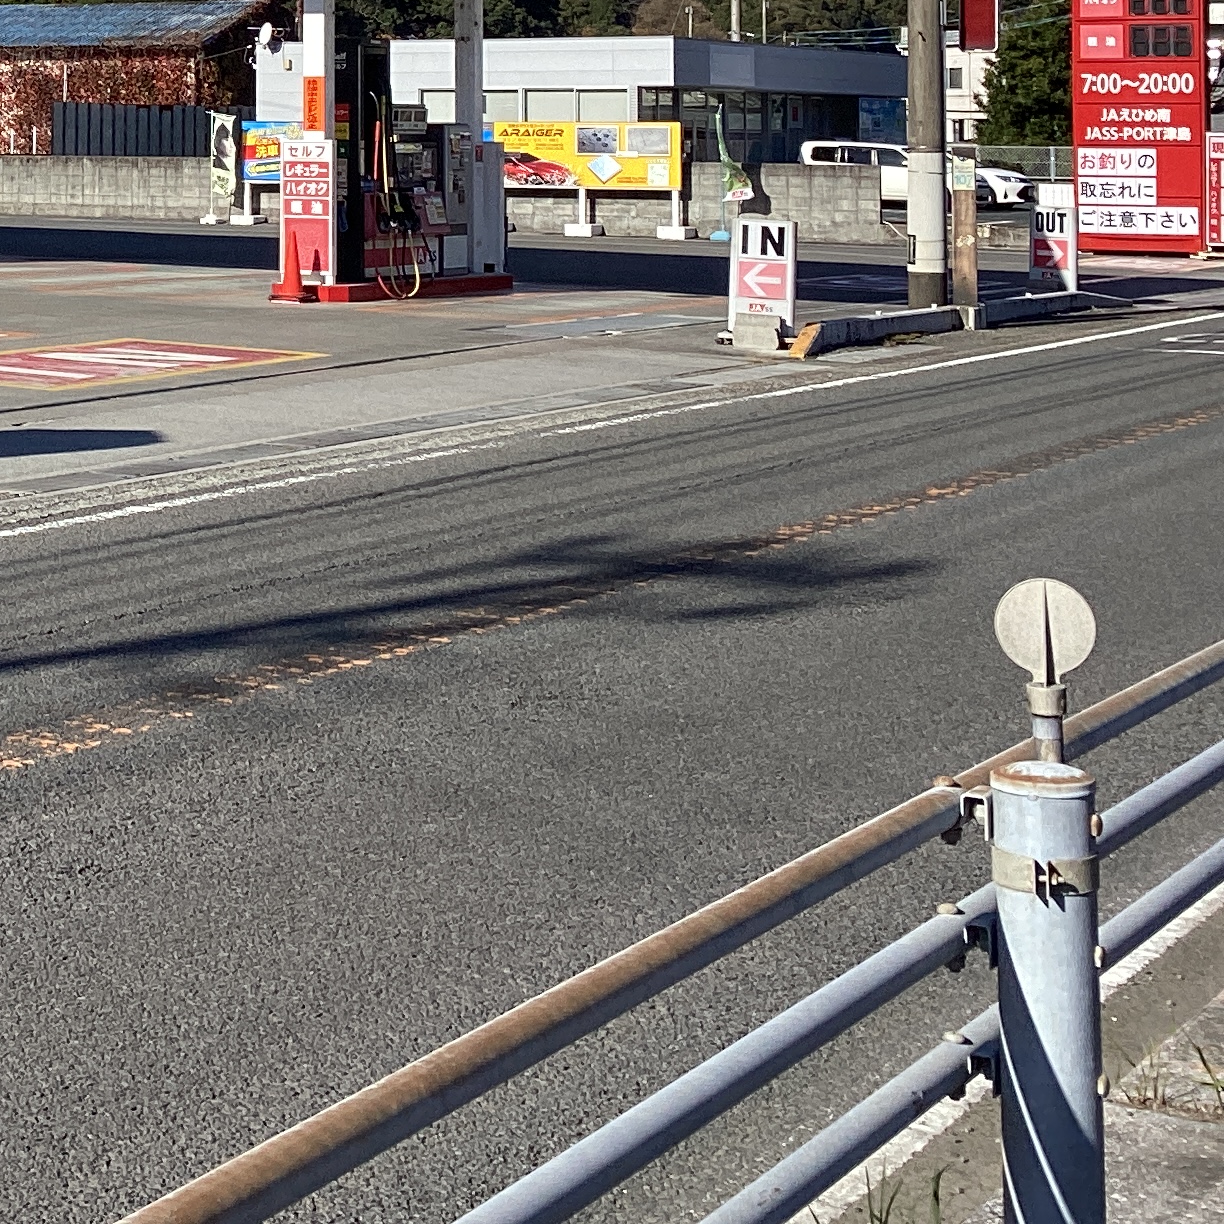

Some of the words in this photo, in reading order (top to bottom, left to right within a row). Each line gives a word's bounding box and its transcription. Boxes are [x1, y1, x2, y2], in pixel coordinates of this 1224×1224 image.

[1100, 107, 1171, 123] JAえひめ南
[498, 128, 565, 138] ARAIGER
[288, 145, 325, 158] セルフ
[1080, 152, 1155, 170] お釣りの
[285, 163, 328, 177] レギュラー
[285, 181, 328, 196] ハイオク
[1080, 181, 1155, 200] 取忘れに
[1036, 211, 1067, 233] OUT
[1081, 209, 1197, 229] ご注意下さい
[741, 225, 785, 257] IN
